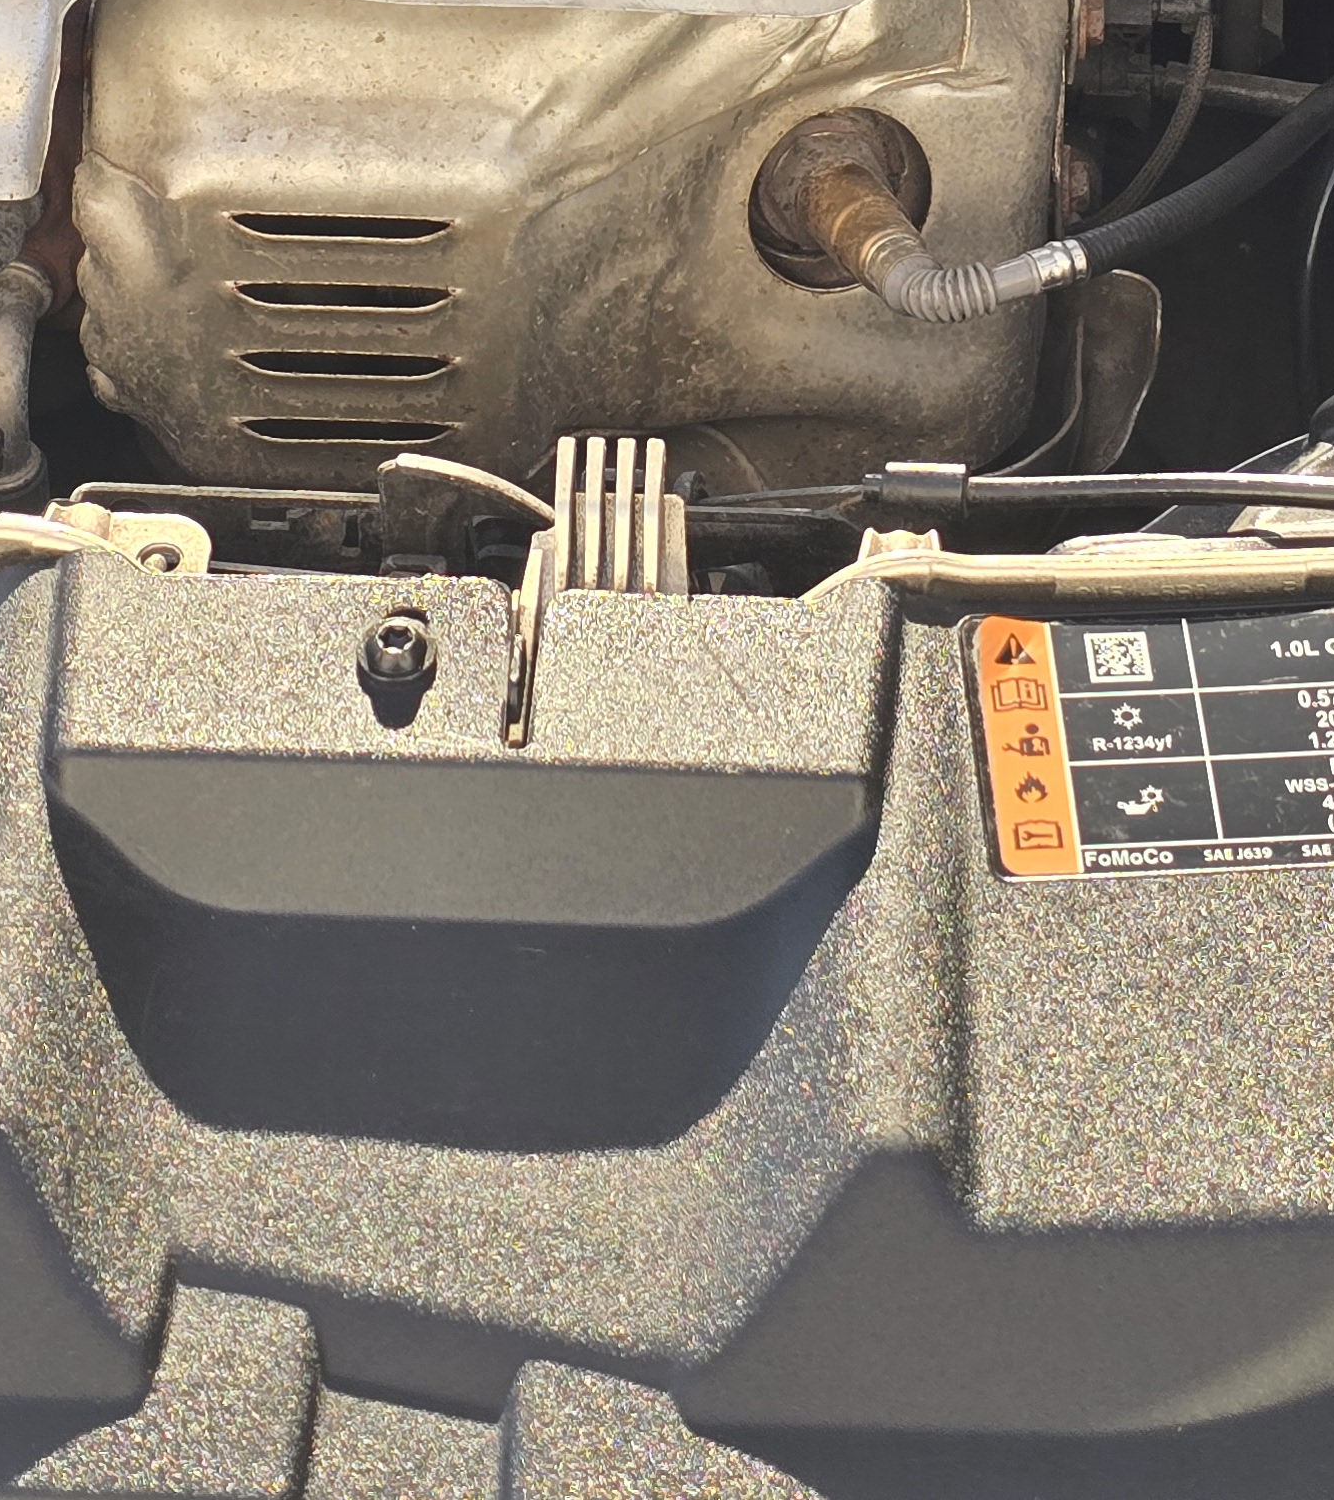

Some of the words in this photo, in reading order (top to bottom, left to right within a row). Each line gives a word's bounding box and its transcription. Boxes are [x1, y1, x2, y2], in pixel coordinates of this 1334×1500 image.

[1270, 639, 1319, 658] 1.0L
[1092, 735, 1173, 752] R-1234yf
[1084, 848, 1174, 867] FoMoCo
[1203, 848, 1234, 862] SAE
[1236, 846, 1273, 860] J639
[1301, 843, 1332, 857] SAE
